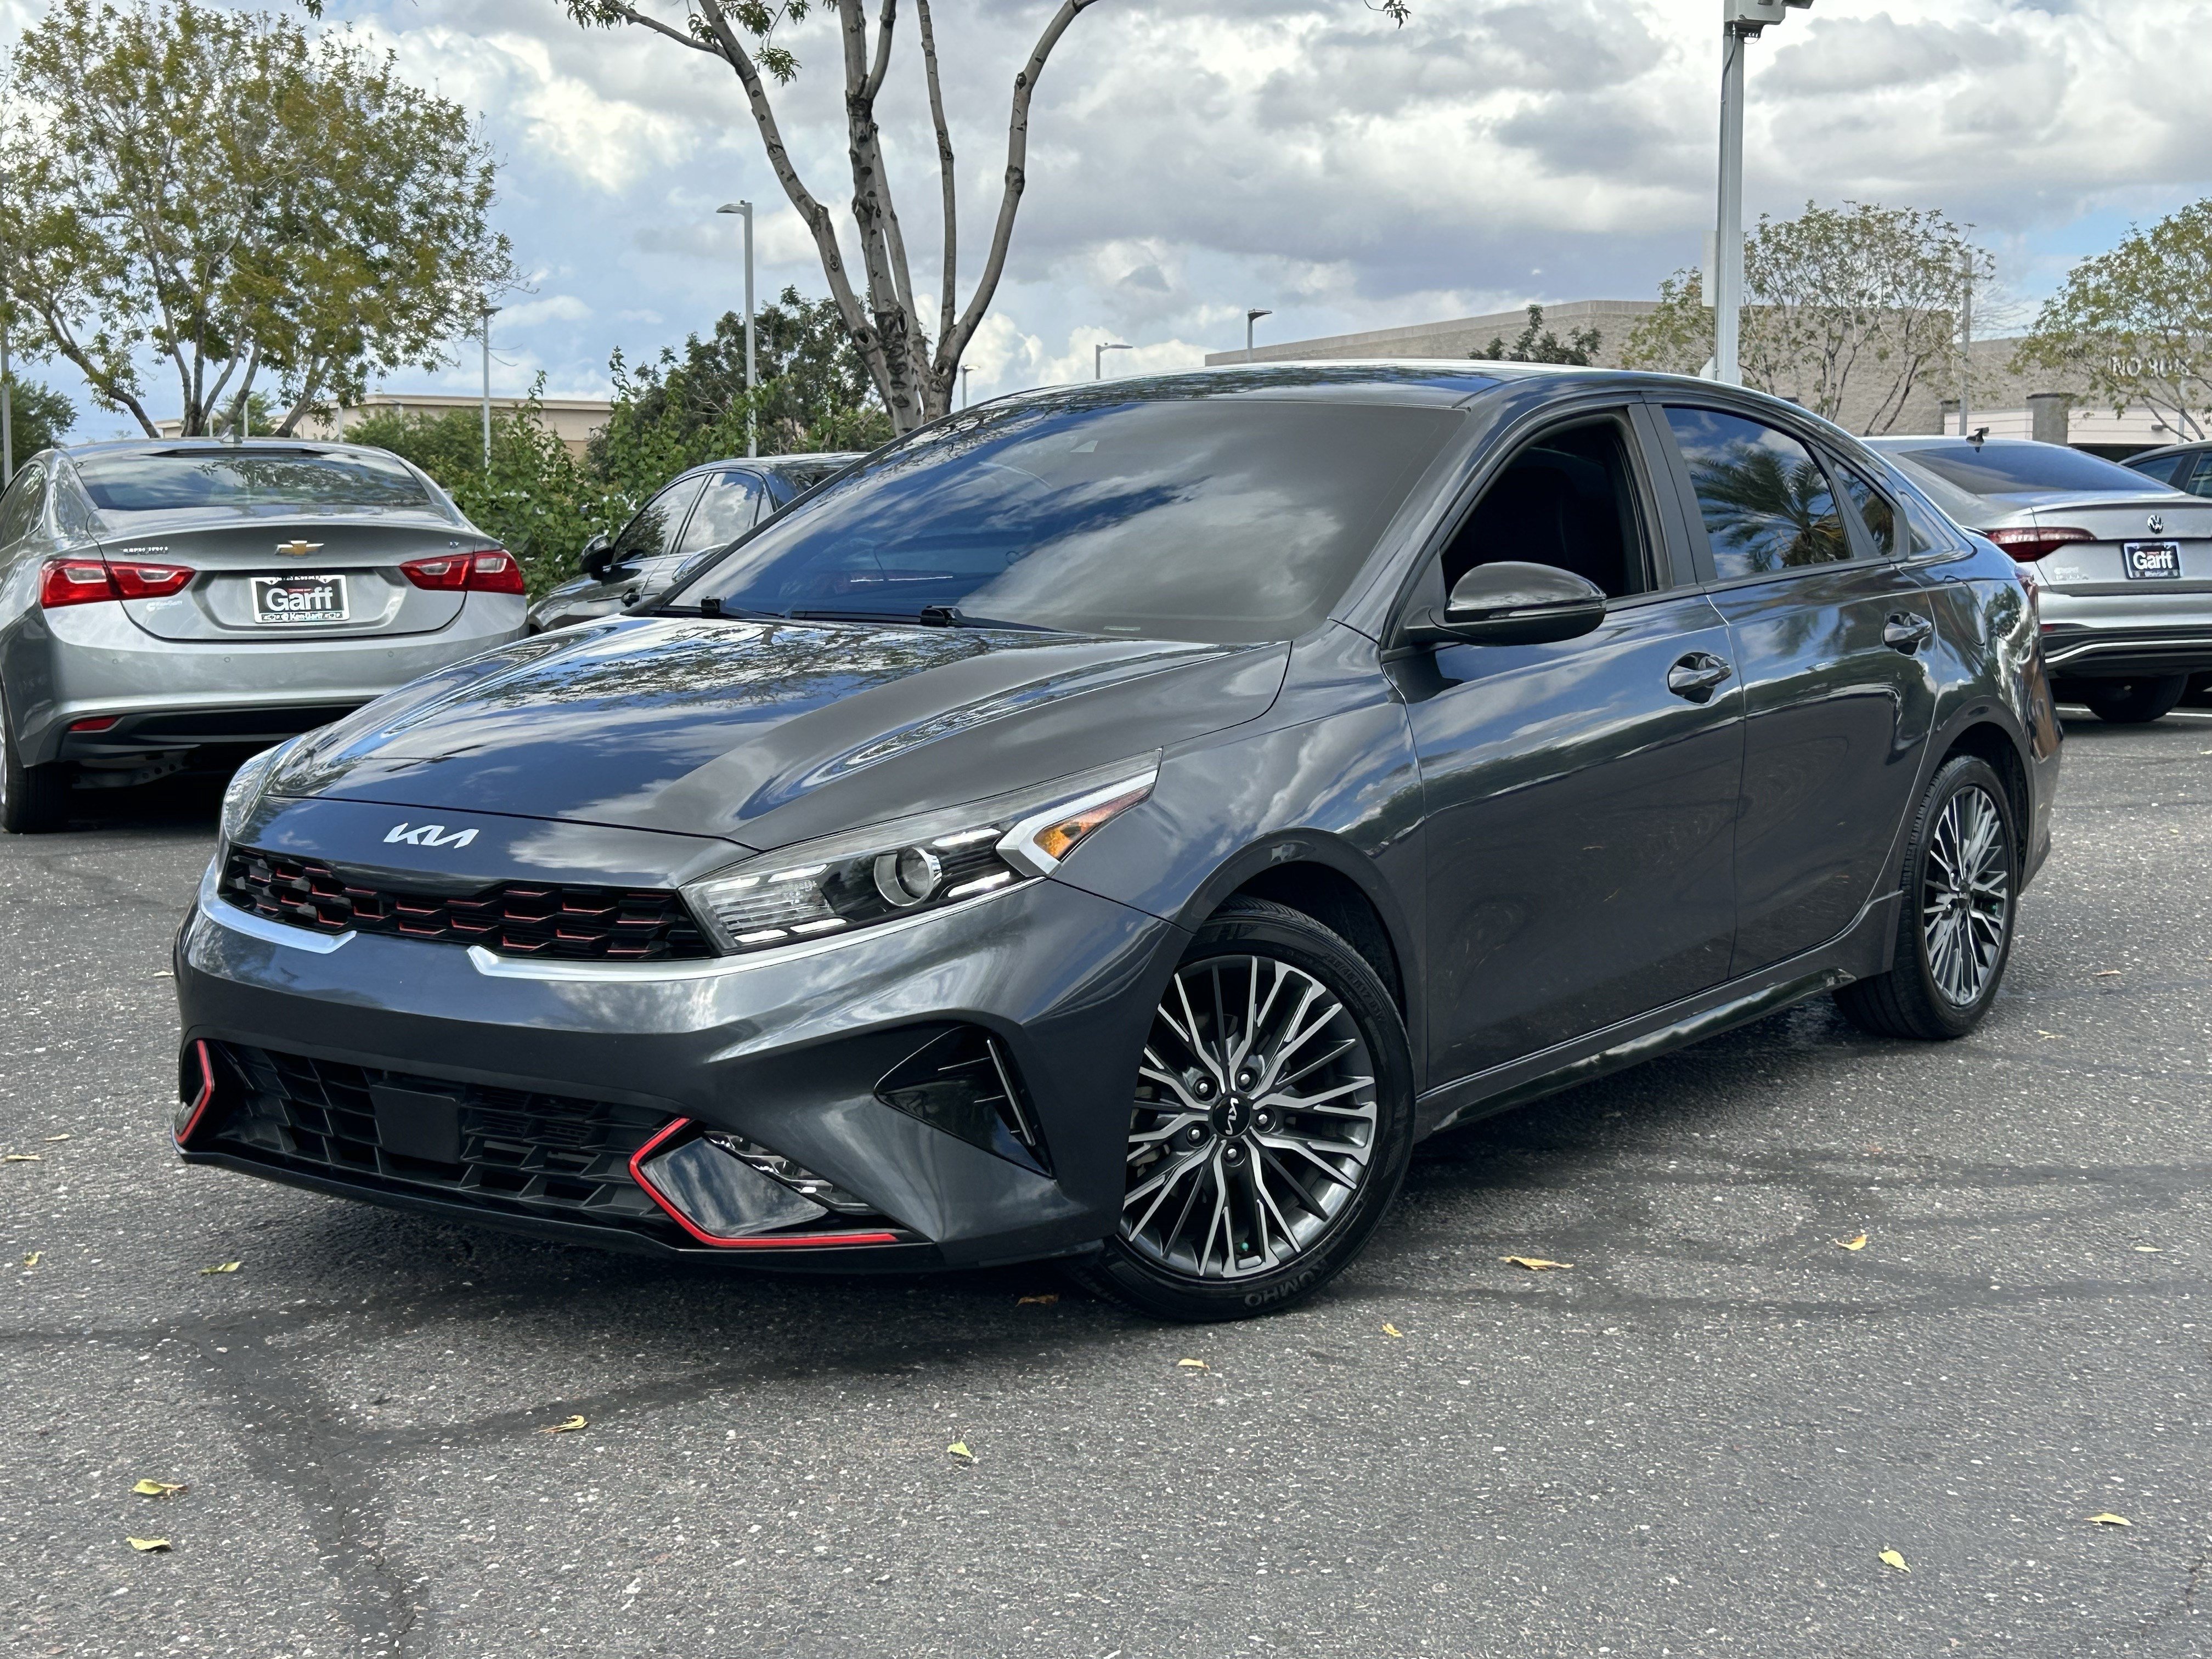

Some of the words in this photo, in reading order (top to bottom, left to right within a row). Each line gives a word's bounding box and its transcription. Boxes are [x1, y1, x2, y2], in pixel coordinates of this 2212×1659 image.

[2133, 550, 2174, 570] Garff
[266, 586, 333, 612] Garff
[383, 822, 480, 849] KIA
[1244, 1259, 1330, 1307] KUMHO
